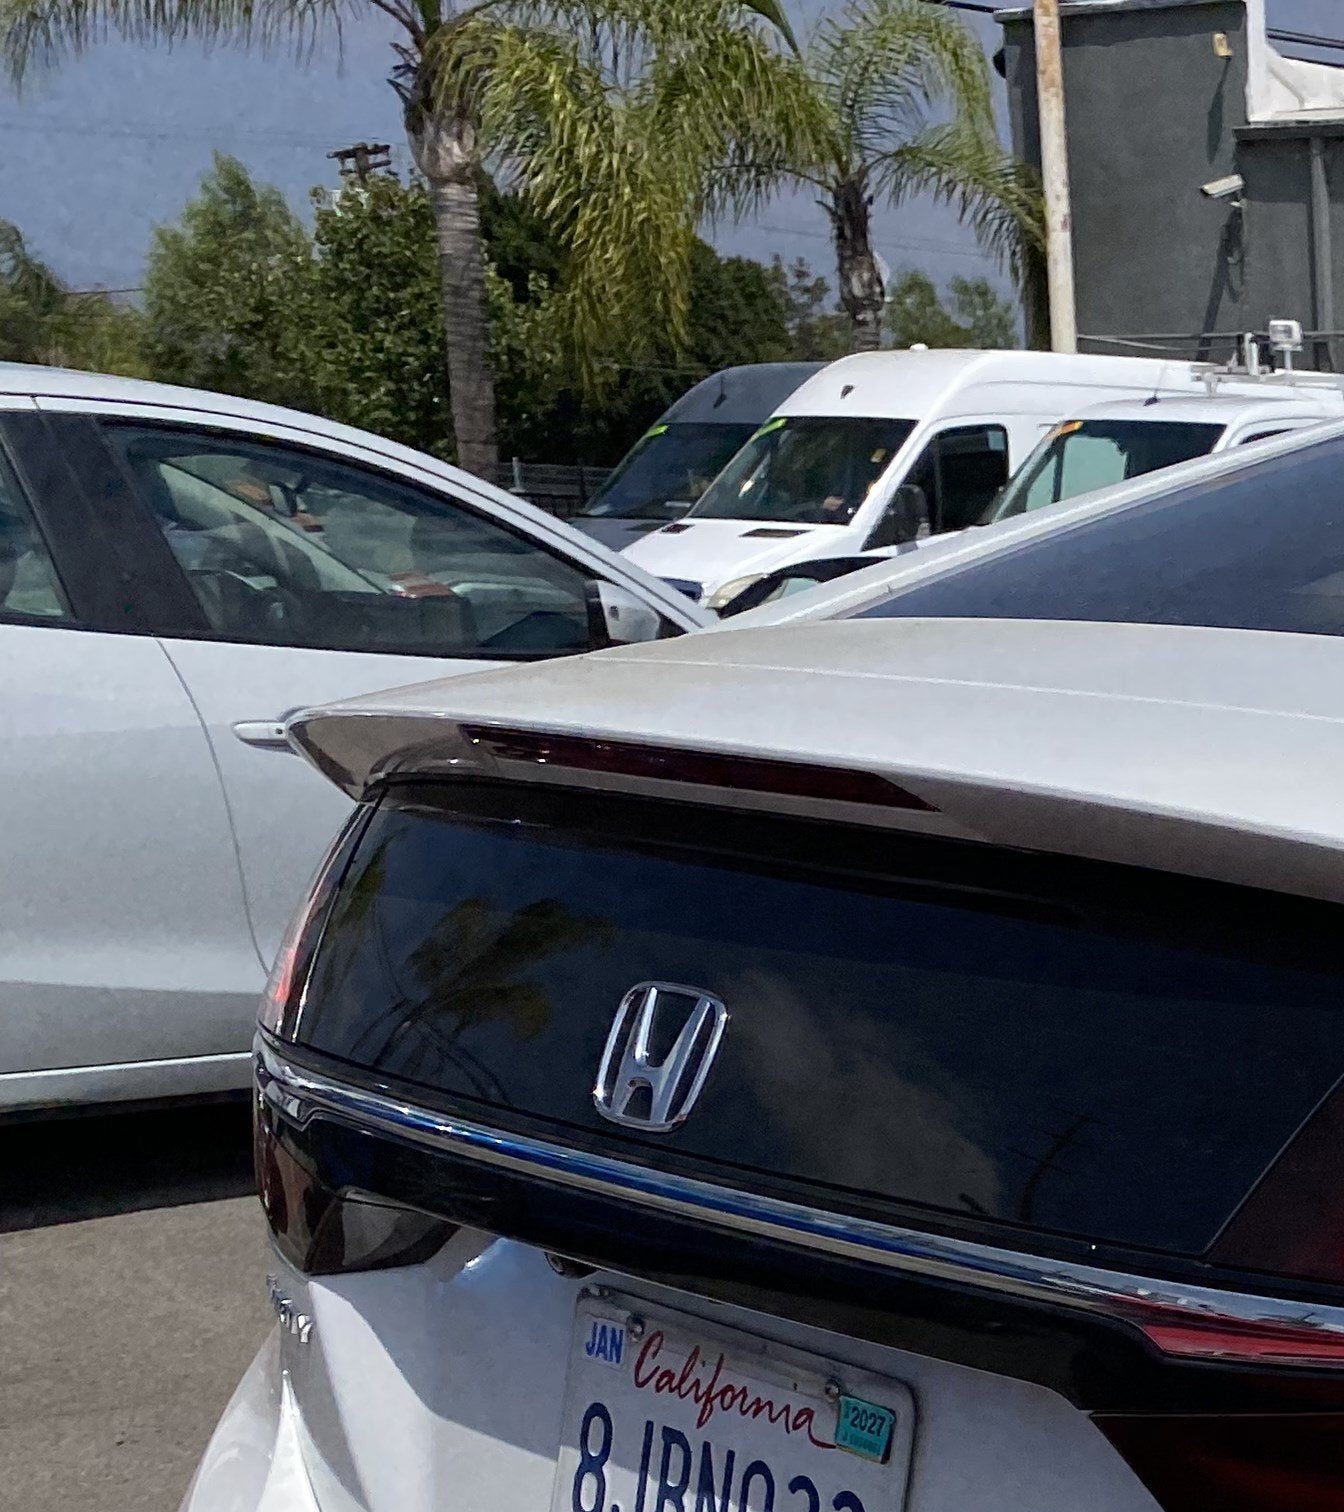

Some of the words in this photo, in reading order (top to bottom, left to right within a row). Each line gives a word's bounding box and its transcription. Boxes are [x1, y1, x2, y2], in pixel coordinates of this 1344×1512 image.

[585, 1321, 624, 1364] JAN
[634, 1331, 837, 1449] California
[851, 1404, 886, 1437] 2027
